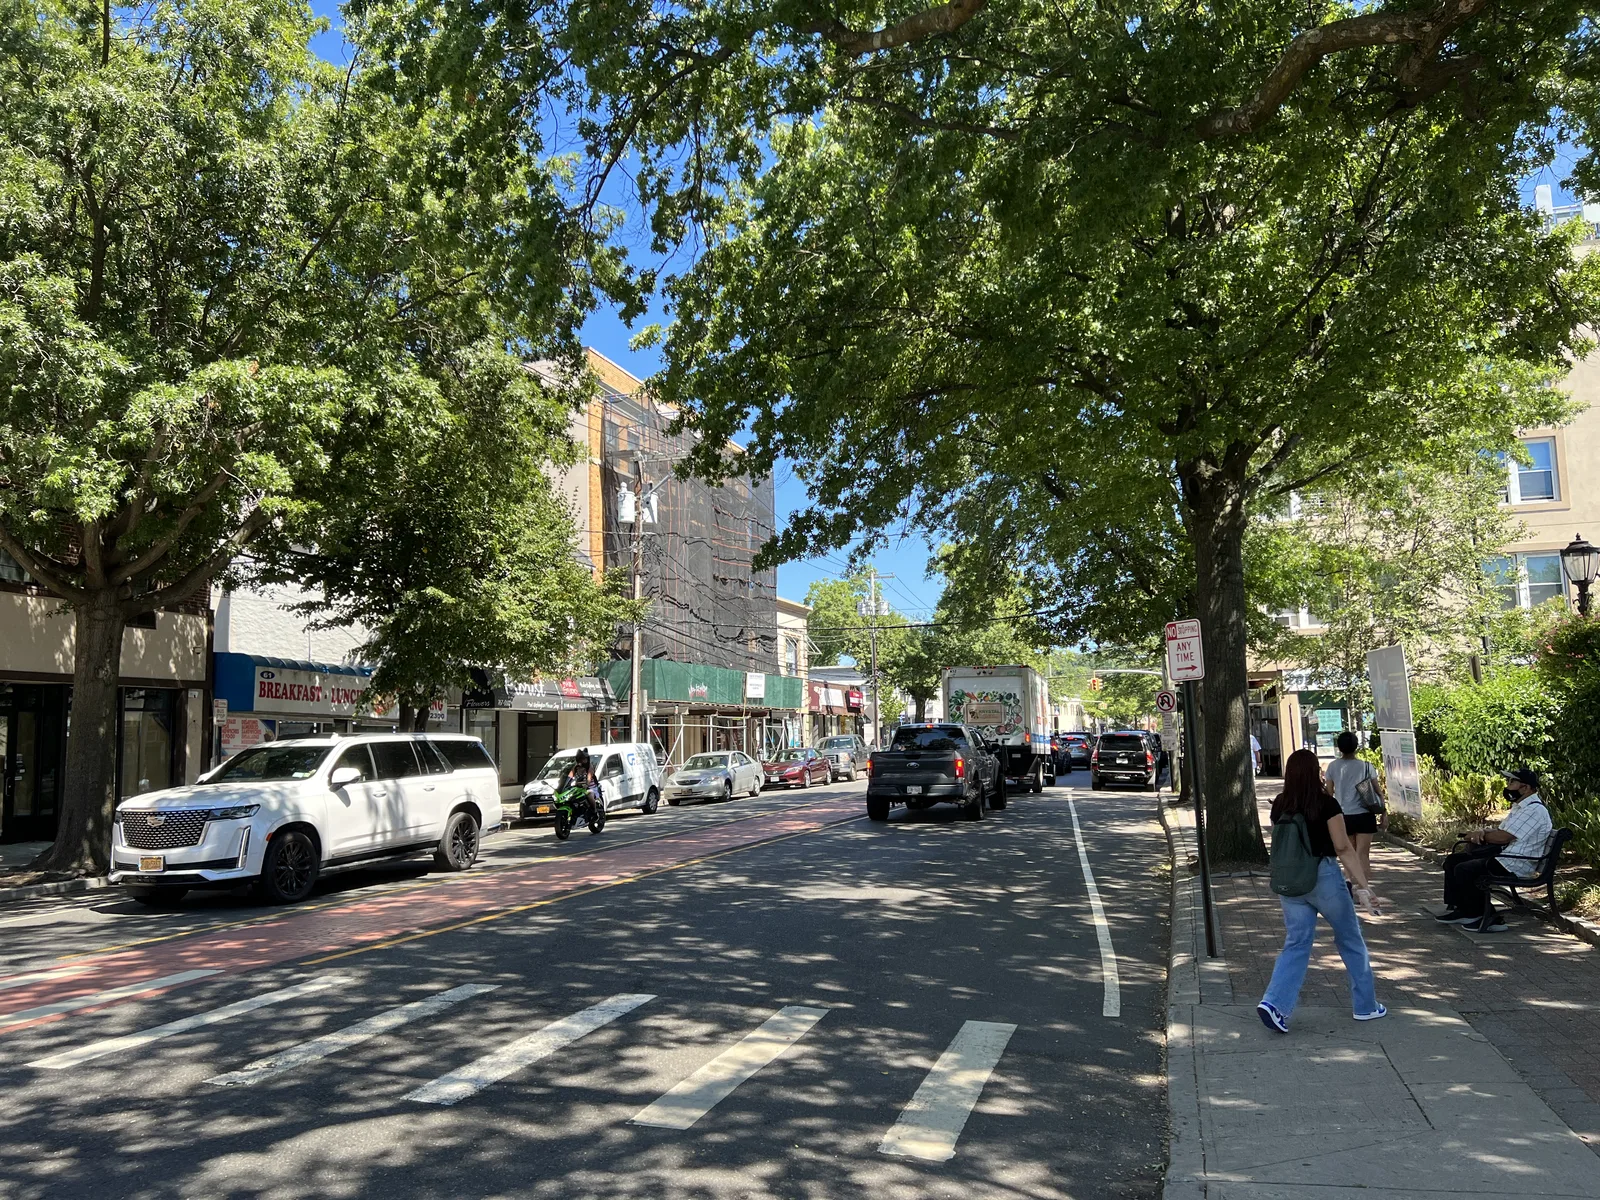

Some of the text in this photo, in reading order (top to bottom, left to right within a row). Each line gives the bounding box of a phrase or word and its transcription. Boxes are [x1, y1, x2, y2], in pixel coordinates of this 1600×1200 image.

[1167, 626, 1177, 638] NO
[1176, 641, 1192, 652] ANY
[1176, 652, 1195, 662] TIME
[258, 681, 323, 703] BREAKFAST
